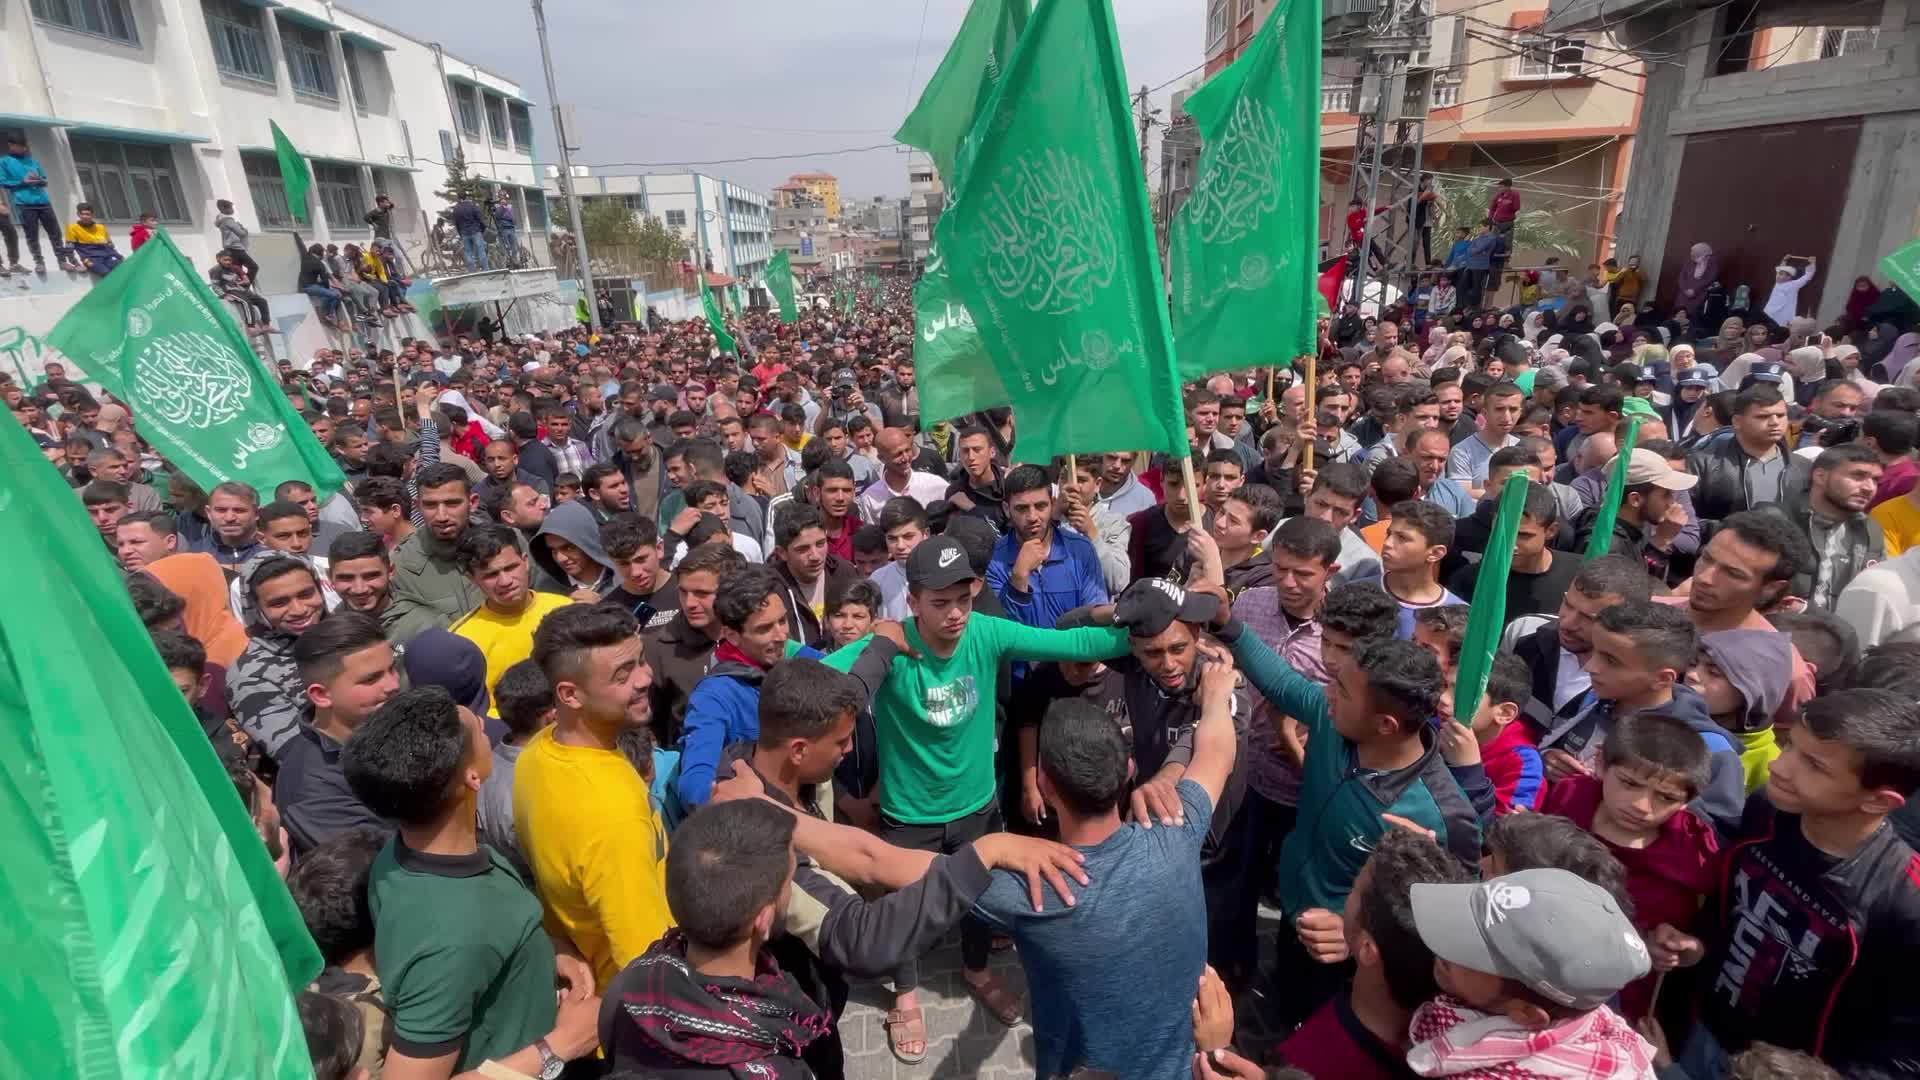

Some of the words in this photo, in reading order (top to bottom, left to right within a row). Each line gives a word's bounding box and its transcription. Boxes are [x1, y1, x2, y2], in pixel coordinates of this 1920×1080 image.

[941, 547, 957, 561] NIKE
[1151, 579, 1185, 606] NIKE
[1786, 879, 1811, 902] AND
